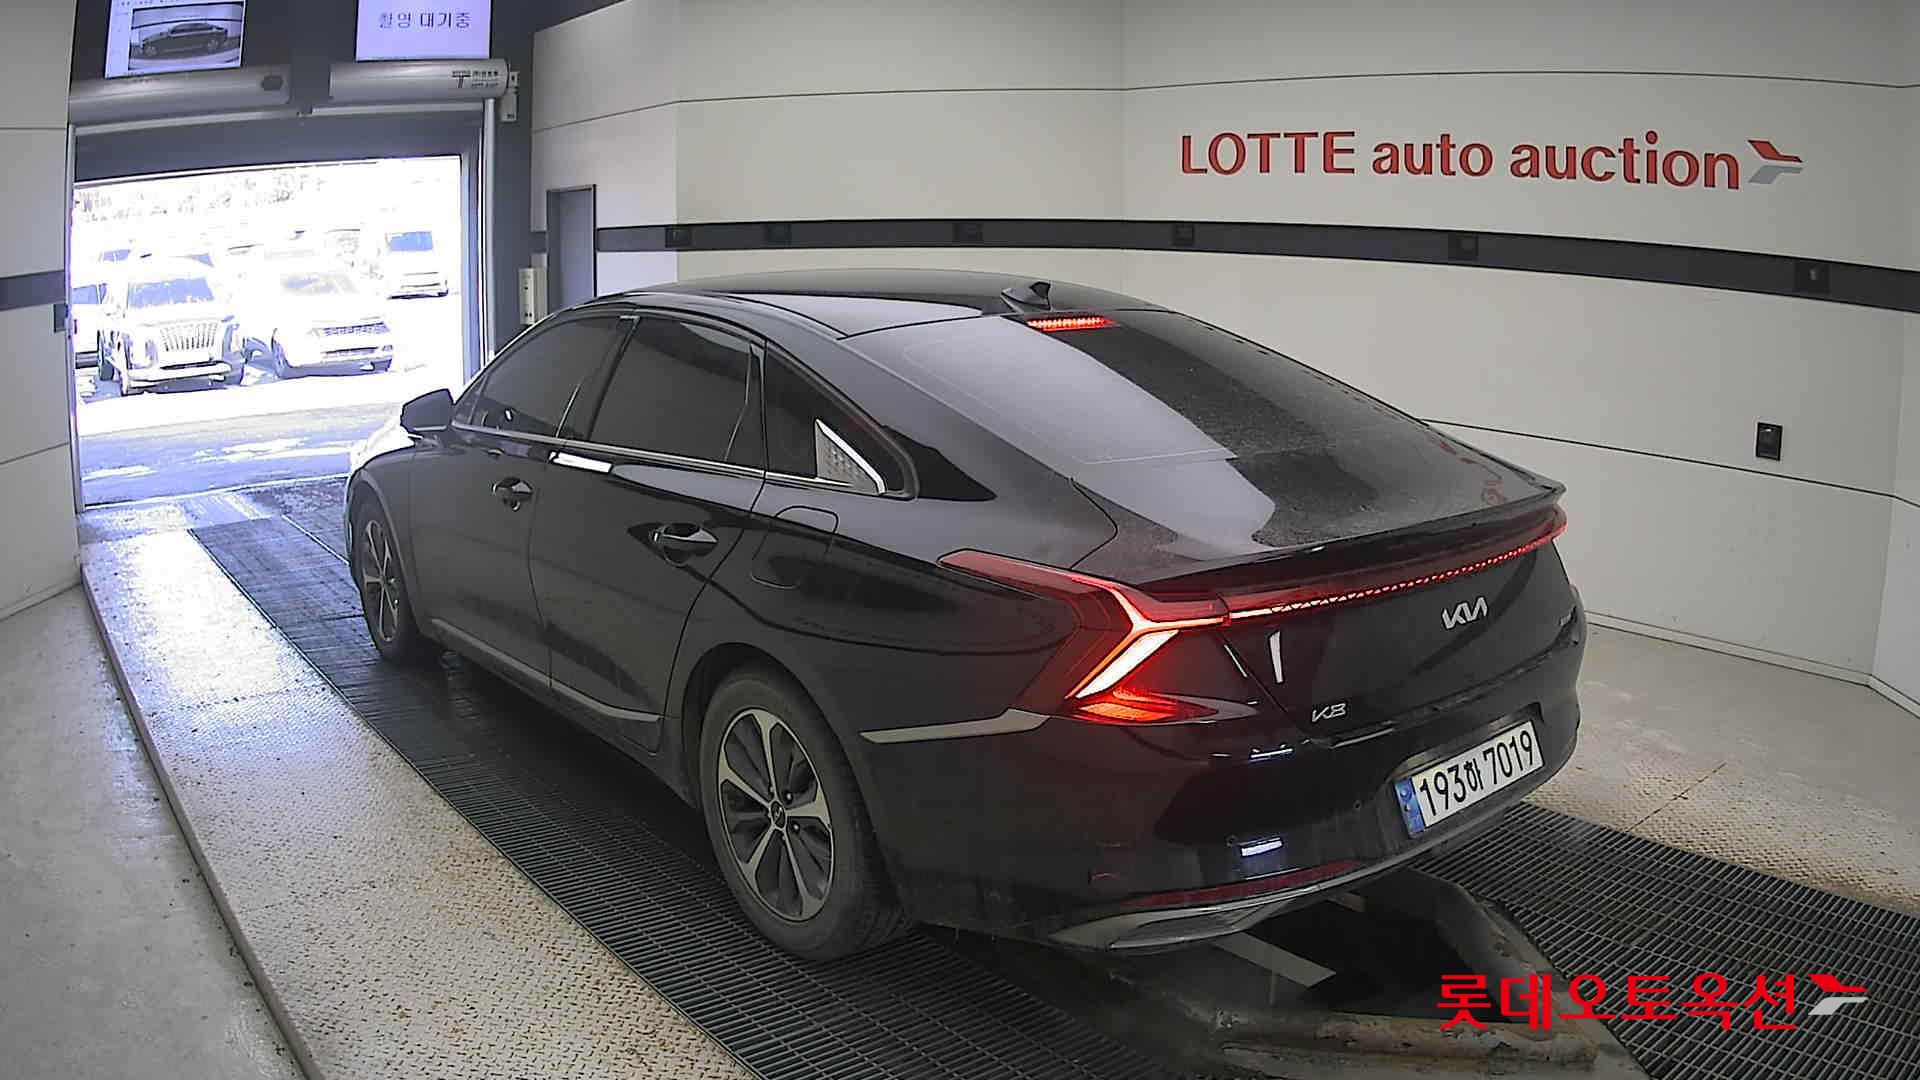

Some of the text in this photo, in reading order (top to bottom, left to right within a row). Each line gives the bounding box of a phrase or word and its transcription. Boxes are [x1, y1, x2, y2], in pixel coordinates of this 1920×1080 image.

[420, 11, 472, 29] 대기중
[1182, 131, 1740, 190] LOTTE auto auction
[1311, 702, 1347, 724] K8
[1419, 730, 1535, 816] 193하 7019
